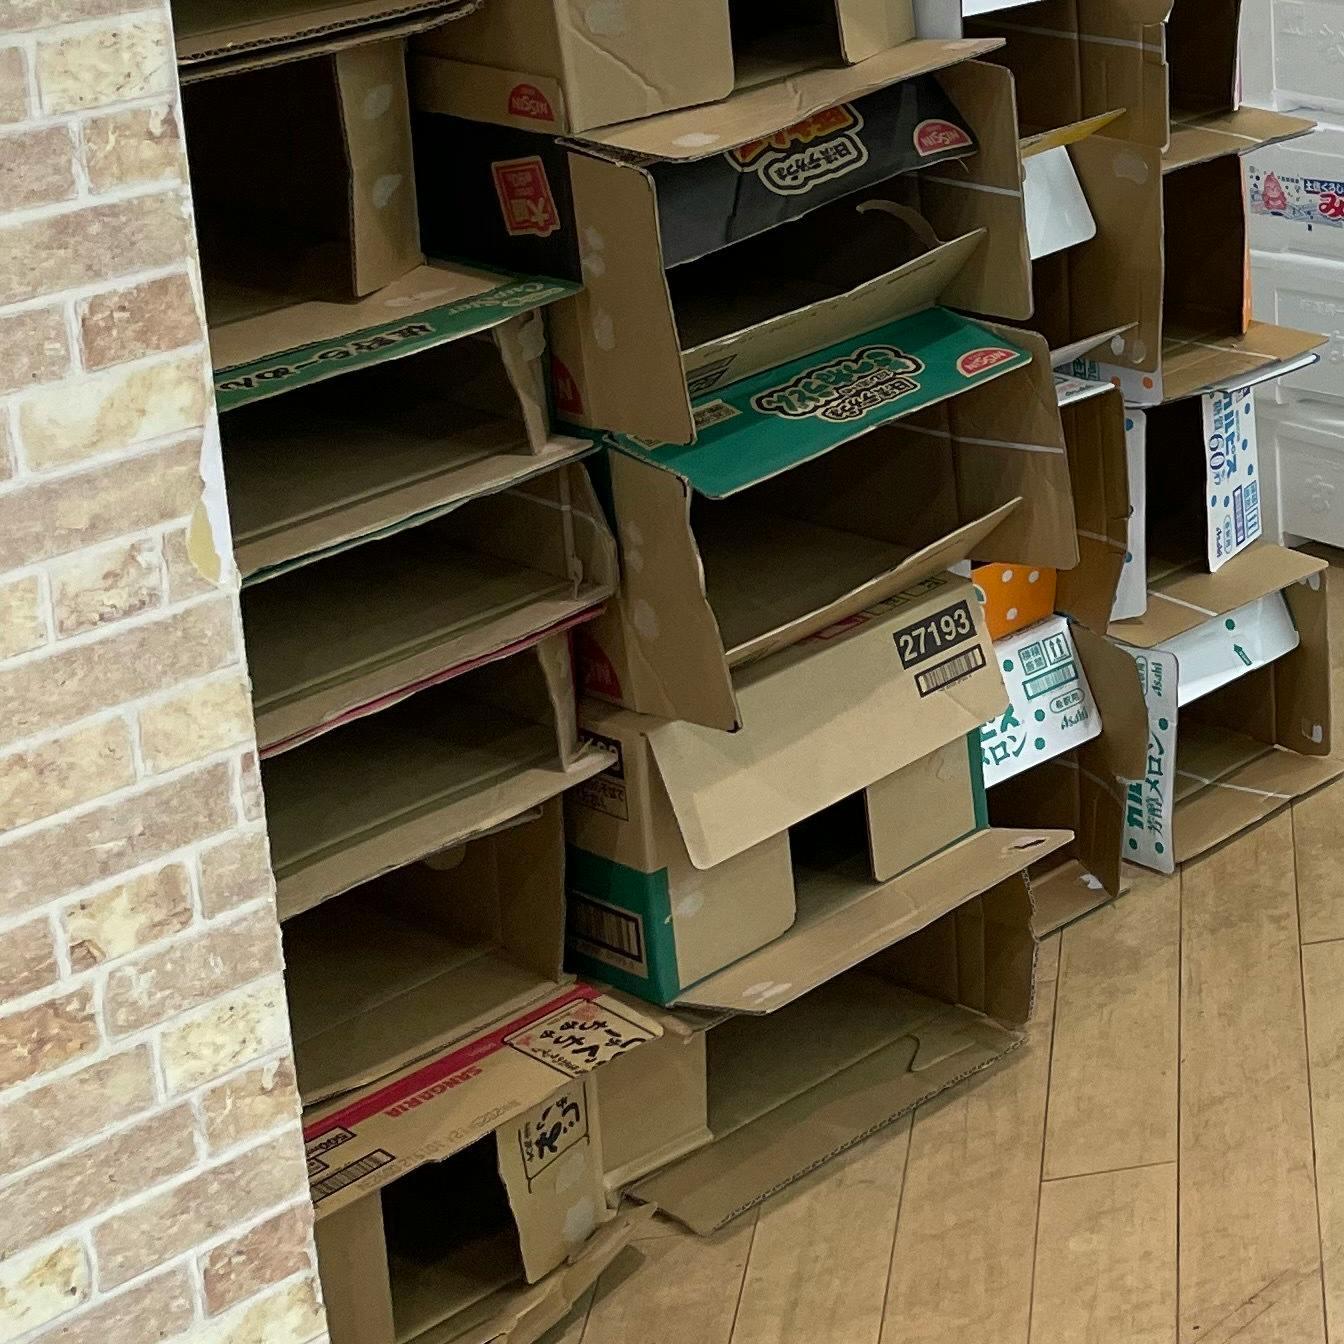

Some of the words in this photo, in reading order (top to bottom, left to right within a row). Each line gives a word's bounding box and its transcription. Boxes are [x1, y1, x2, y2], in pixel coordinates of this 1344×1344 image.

[511, 94, 549, 115] NISSIN
[922, 129, 961, 146] NISSIN
[898, 608, 973, 662] 27193
[1150, 661, 1163, 697] Asahi
[1061, 708, 1089, 731] Asahi
[383, 1066, 483, 1118] SANGARIA
